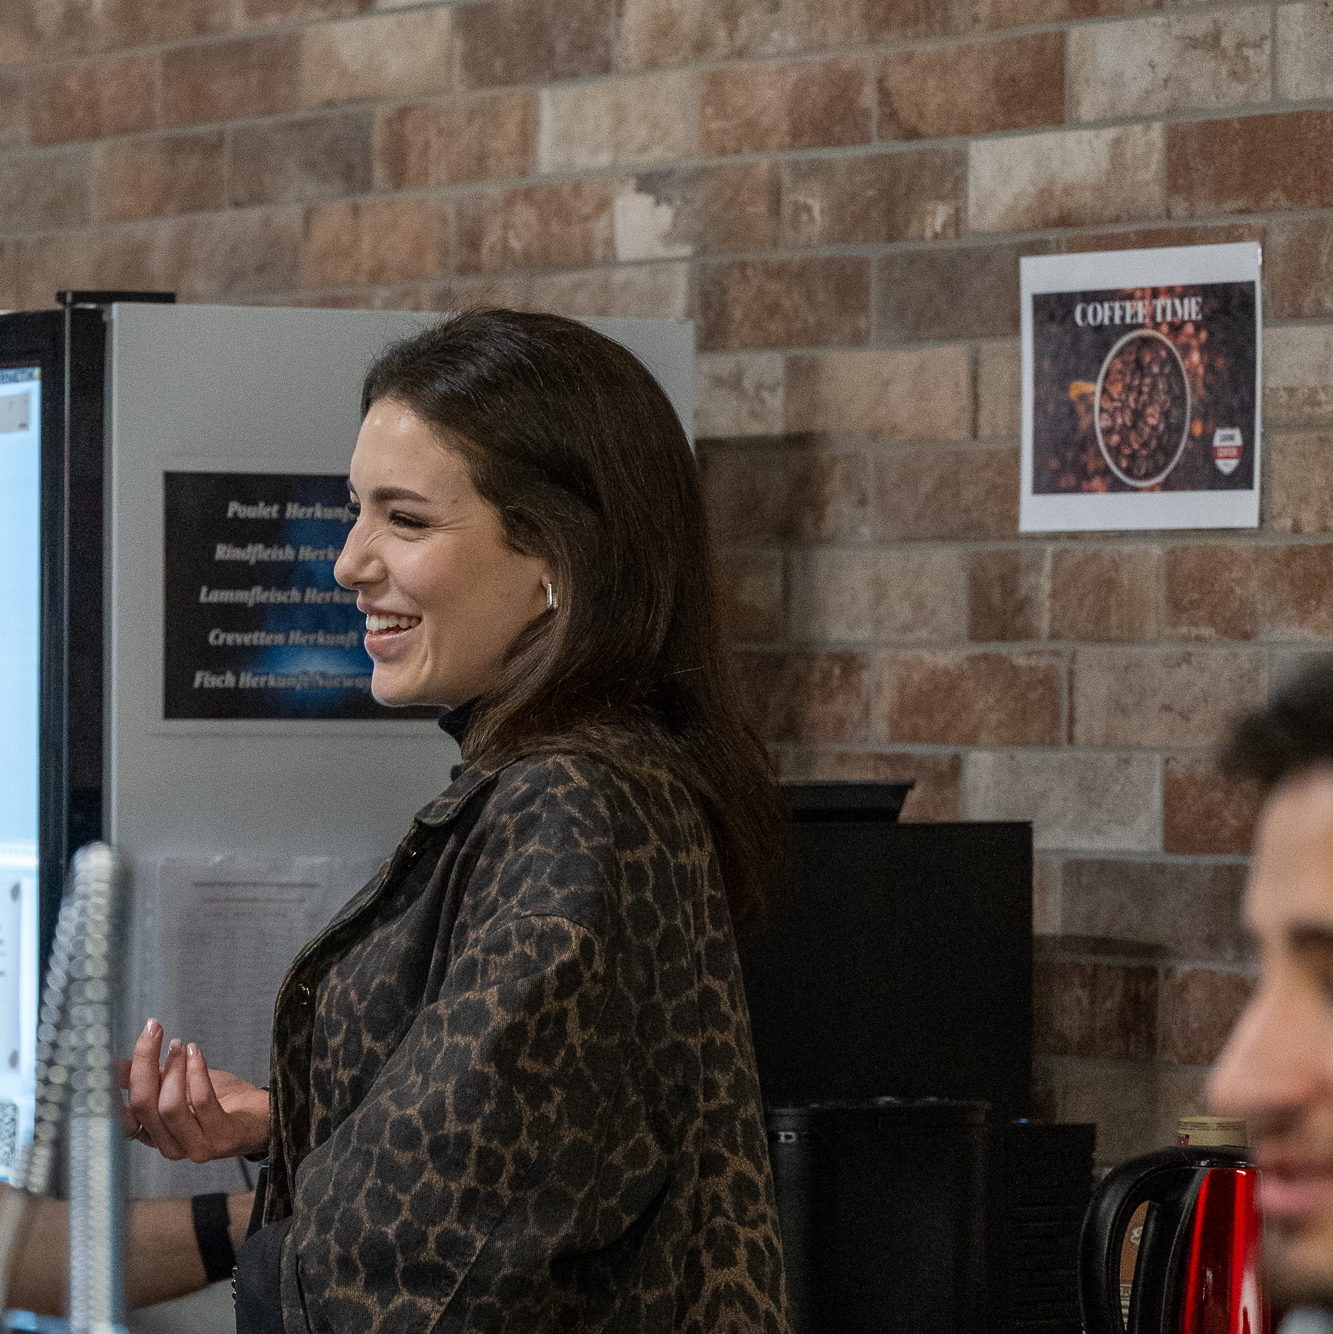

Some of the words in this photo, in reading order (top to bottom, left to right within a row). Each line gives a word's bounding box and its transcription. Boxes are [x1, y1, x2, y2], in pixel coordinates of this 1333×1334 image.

[1074, 298, 1150, 327] COFFEE
[1152, 296, 1203, 323] TIME
[226, 500, 280, 519] Poulet
[199, 585, 302, 607] Lammfleisch
[208, 627, 286, 647] Crevetten
[287, 629, 359, 650] Herkunft
[193, 670, 236, 689] Fisch
